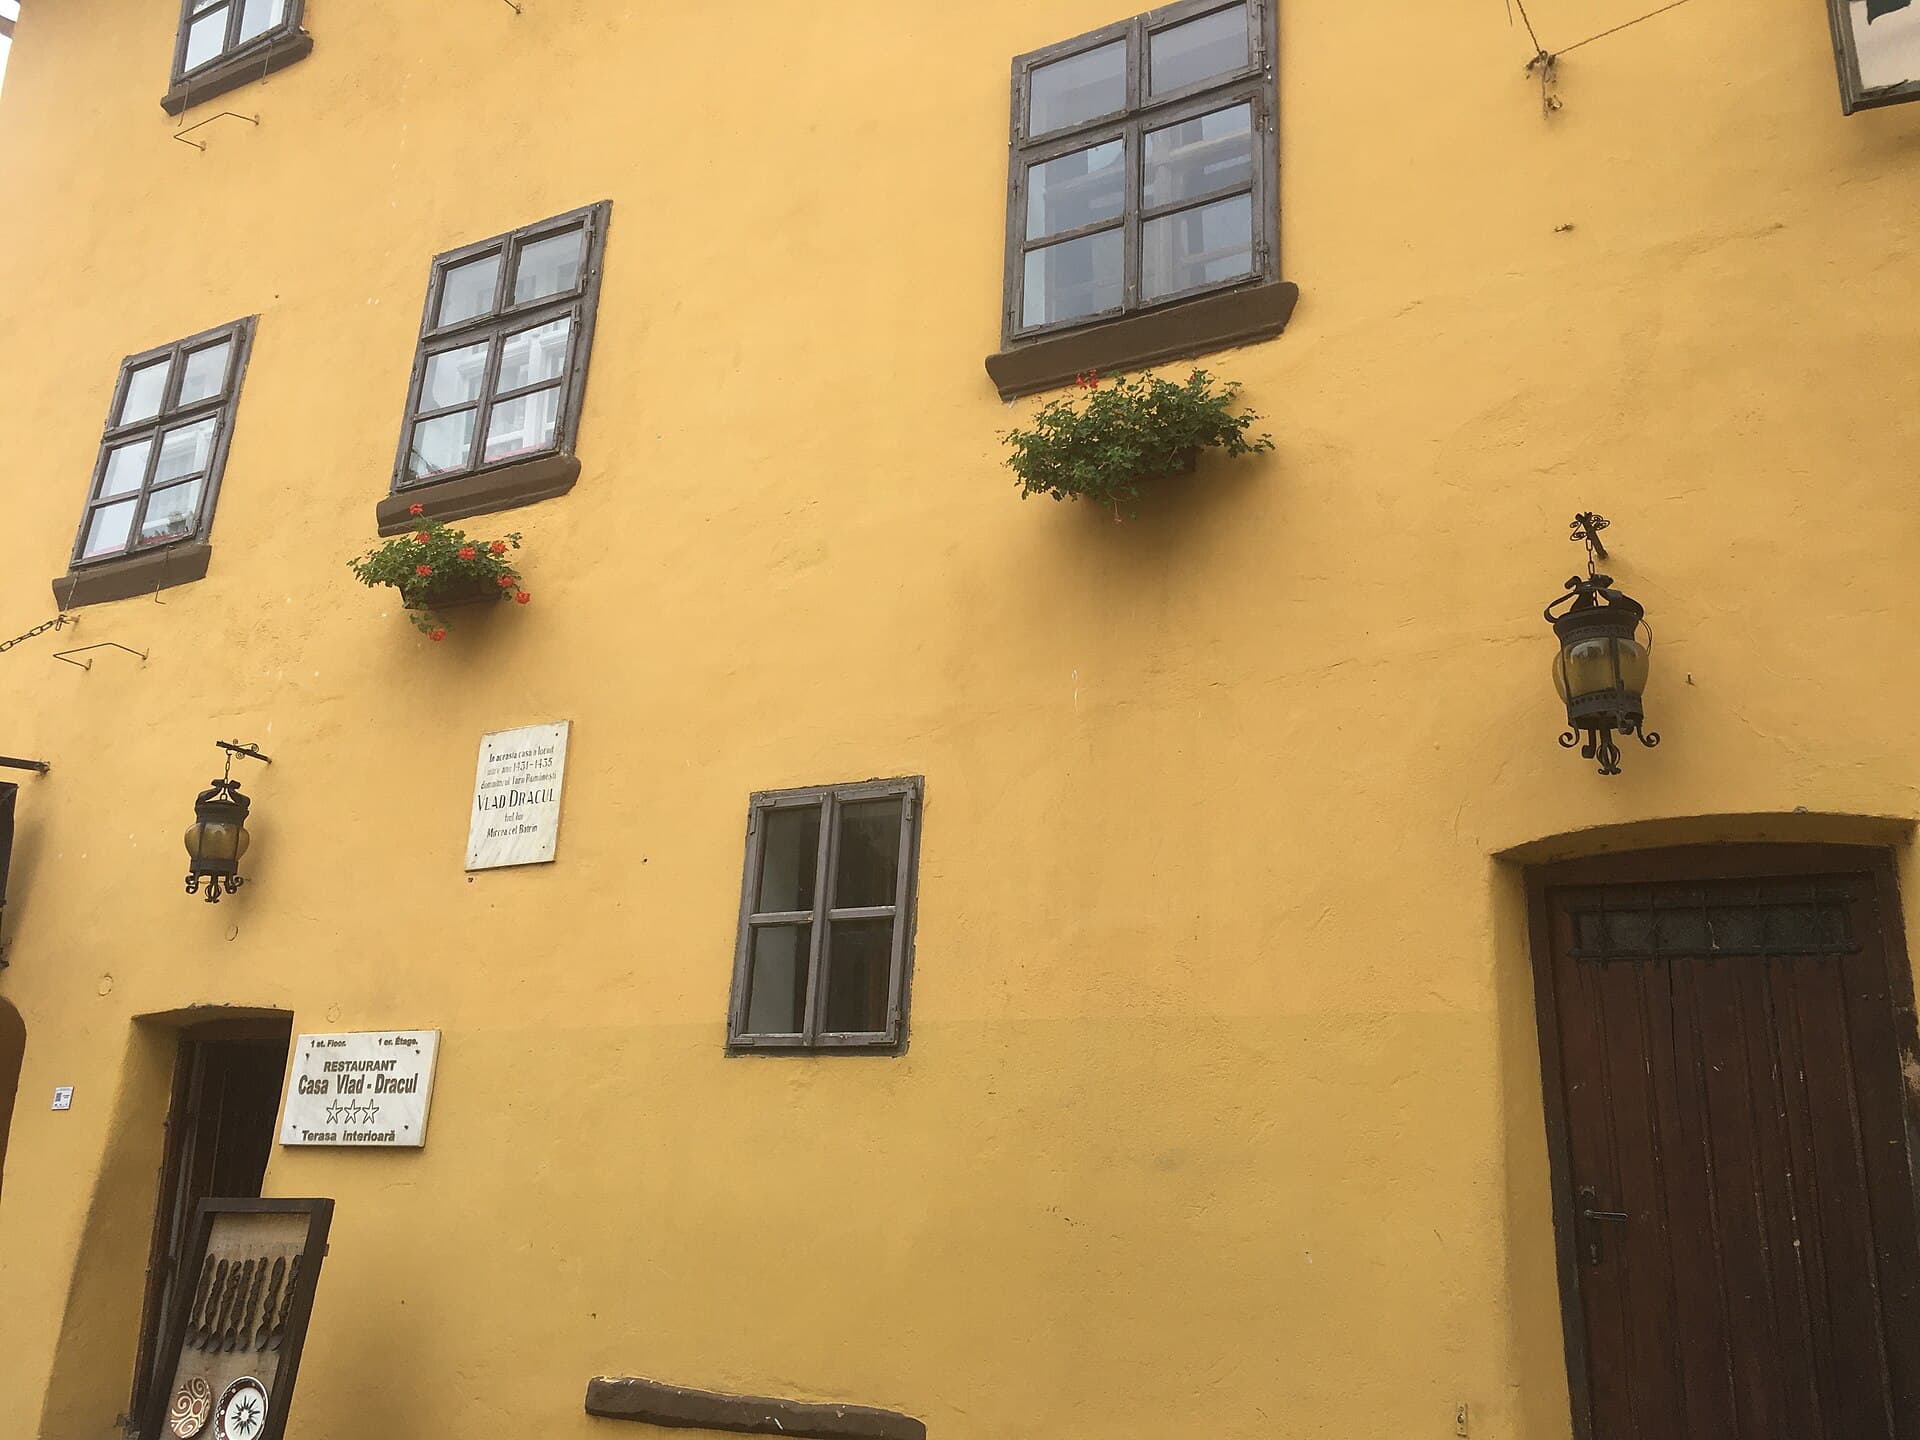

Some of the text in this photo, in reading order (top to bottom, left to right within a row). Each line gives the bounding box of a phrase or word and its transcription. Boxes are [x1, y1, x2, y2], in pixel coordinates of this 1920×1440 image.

[478, 788, 554, 811] VLAD DRACUL
[323, 1060, 397, 1072] RESTAURANT
[298, 1075, 329, 1095] Casa
[375, 1073, 418, 1094] Dracul
[302, 1130, 337, 1142] Terasa
